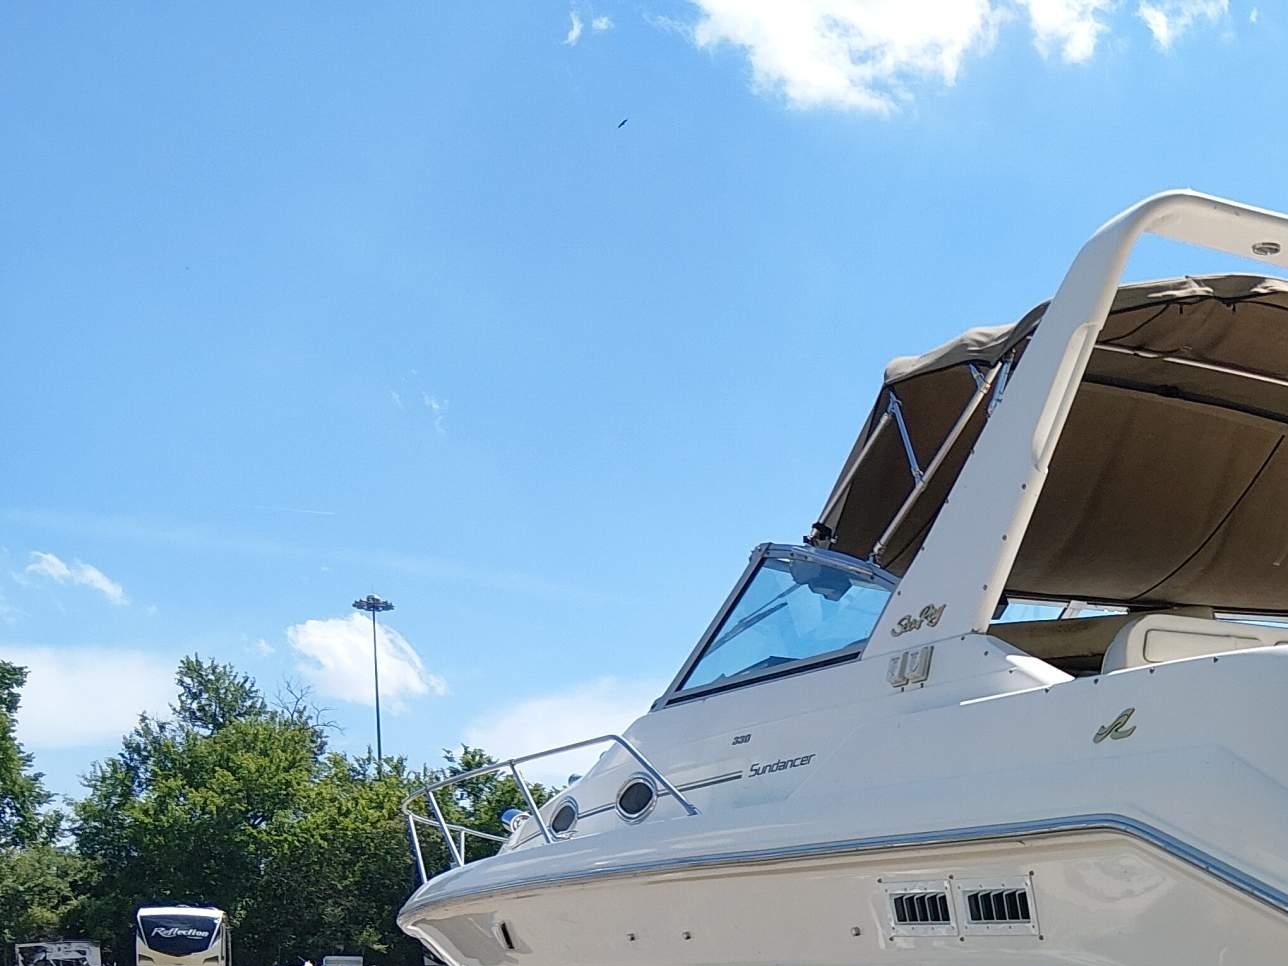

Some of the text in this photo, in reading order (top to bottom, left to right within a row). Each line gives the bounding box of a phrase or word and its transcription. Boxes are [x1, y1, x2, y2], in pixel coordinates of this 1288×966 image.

[731, 734, 752, 746] 330
[748, 753, 816, 778] Sundancer
[151, 927, 210, 940] Reflection
